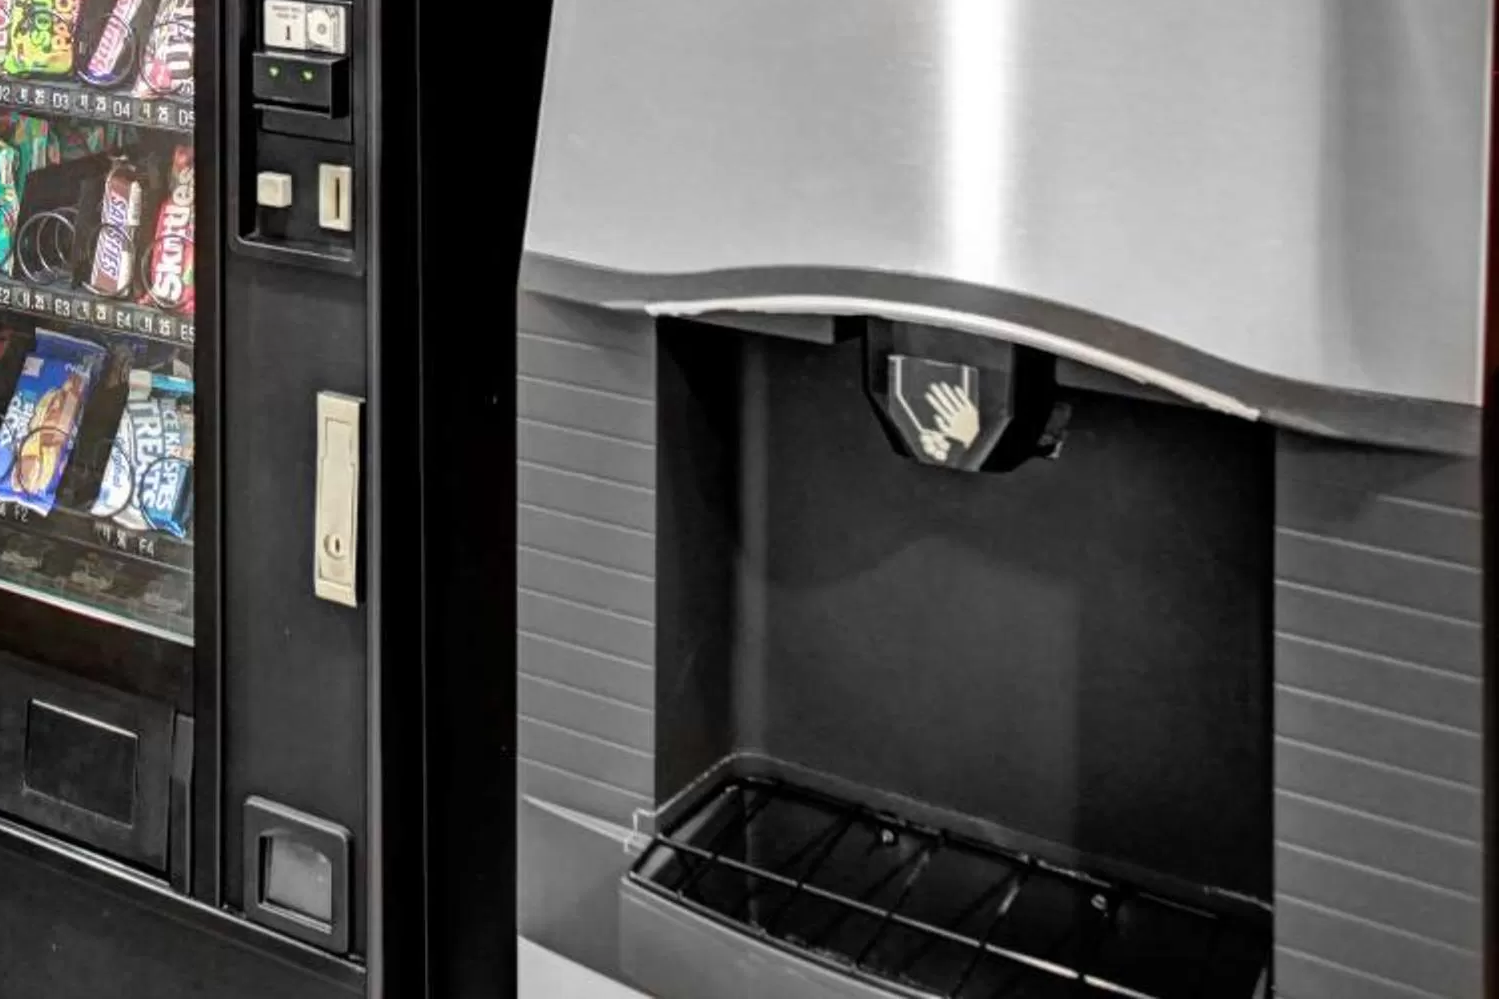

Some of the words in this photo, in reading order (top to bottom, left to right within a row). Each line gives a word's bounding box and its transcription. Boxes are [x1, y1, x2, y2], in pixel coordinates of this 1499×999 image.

[52, 93, 69, 110] D3
[152, 167, 194, 300] Skittles
[54, 298, 71, 316] E3
[116, 311, 131, 329] E4
